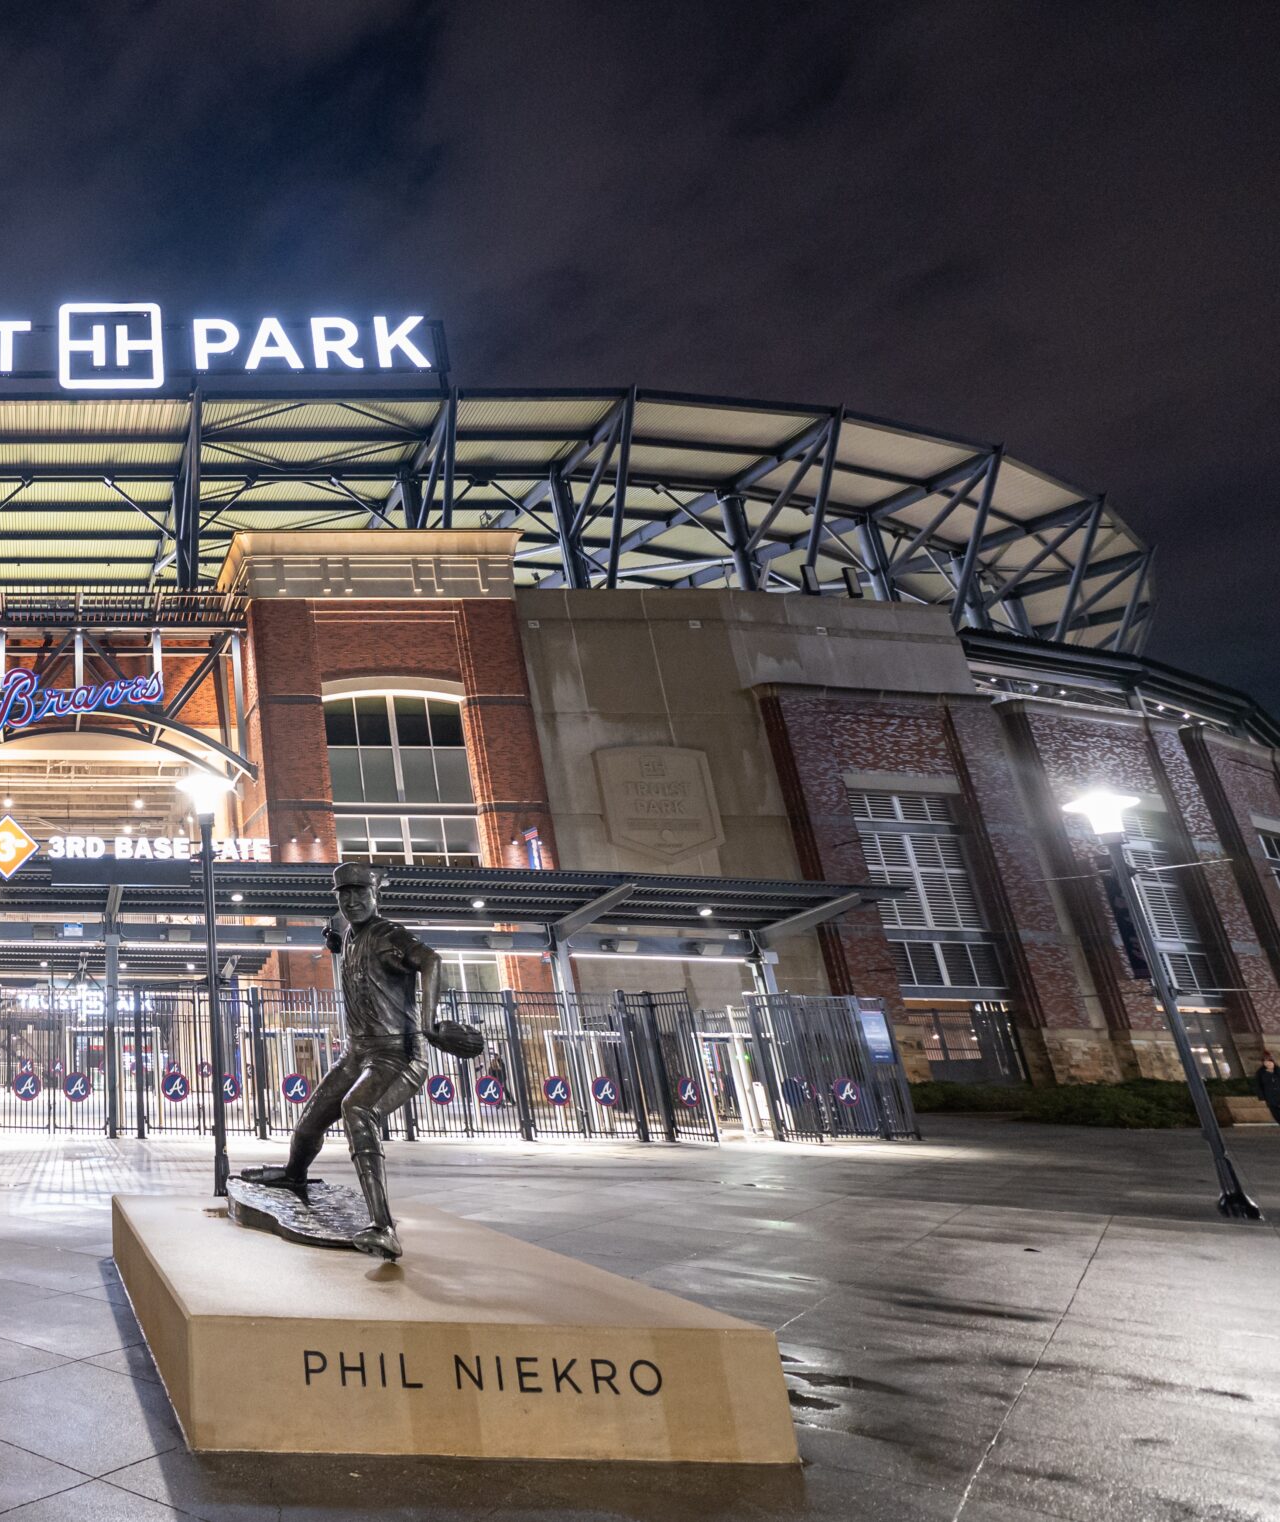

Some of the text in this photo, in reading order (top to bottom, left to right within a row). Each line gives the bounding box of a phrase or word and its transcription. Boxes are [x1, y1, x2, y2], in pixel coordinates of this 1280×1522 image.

[192, 315, 432, 370] PARK
[48, 836, 106, 859] 3RD
[115, 836, 191, 859] BASE
[303, 1349, 663, 1397] PHIL NIEKRO
